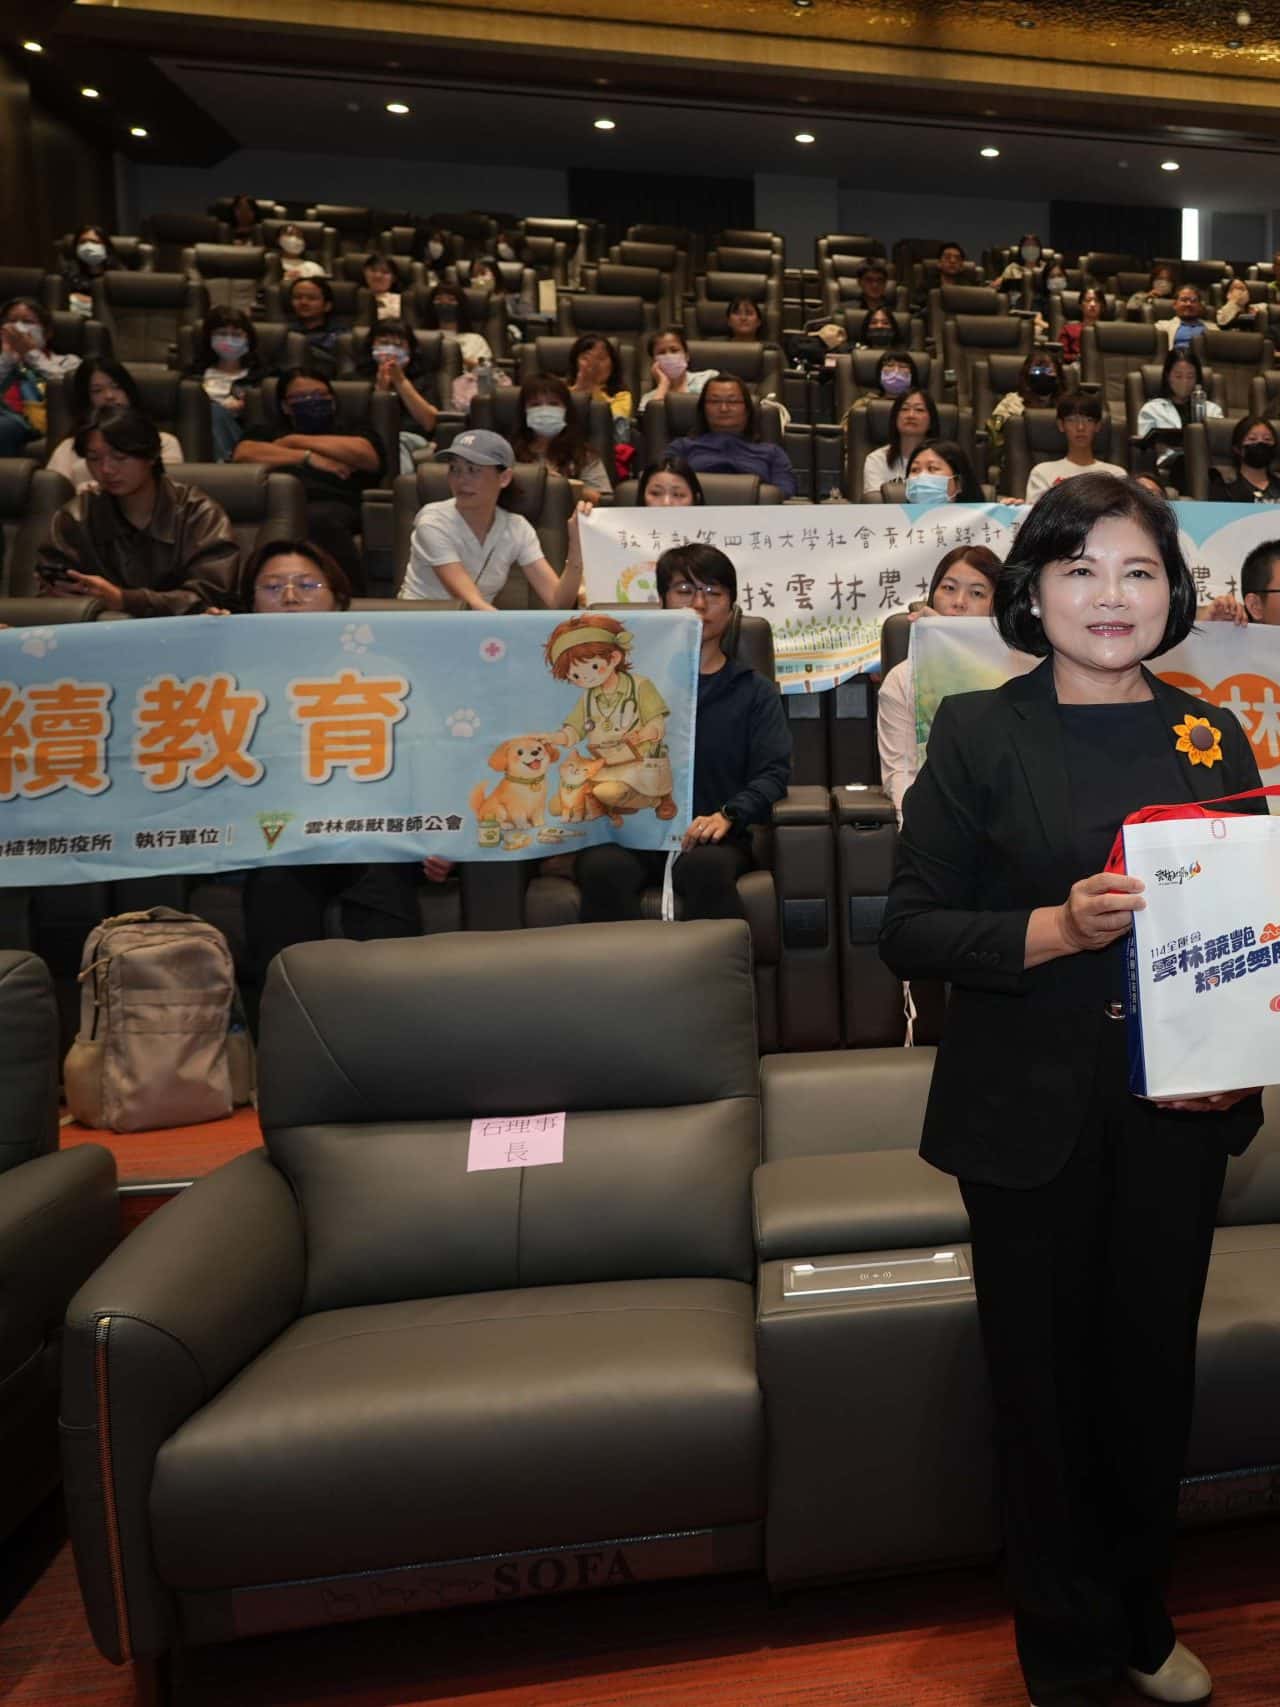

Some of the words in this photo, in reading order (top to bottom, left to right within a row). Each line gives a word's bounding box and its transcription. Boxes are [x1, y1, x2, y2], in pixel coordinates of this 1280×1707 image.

[0, 672, 407, 796] 續教育
[0, 833, 113, 857] 植物防疫所
[135, 827, 220, 849] 執行單位
[304, 813, 464, 835] 雲林縣獸醫師公會
[505, 1141, 529, 1162] 長
[493, 1549, 640, 1599] SOFA
